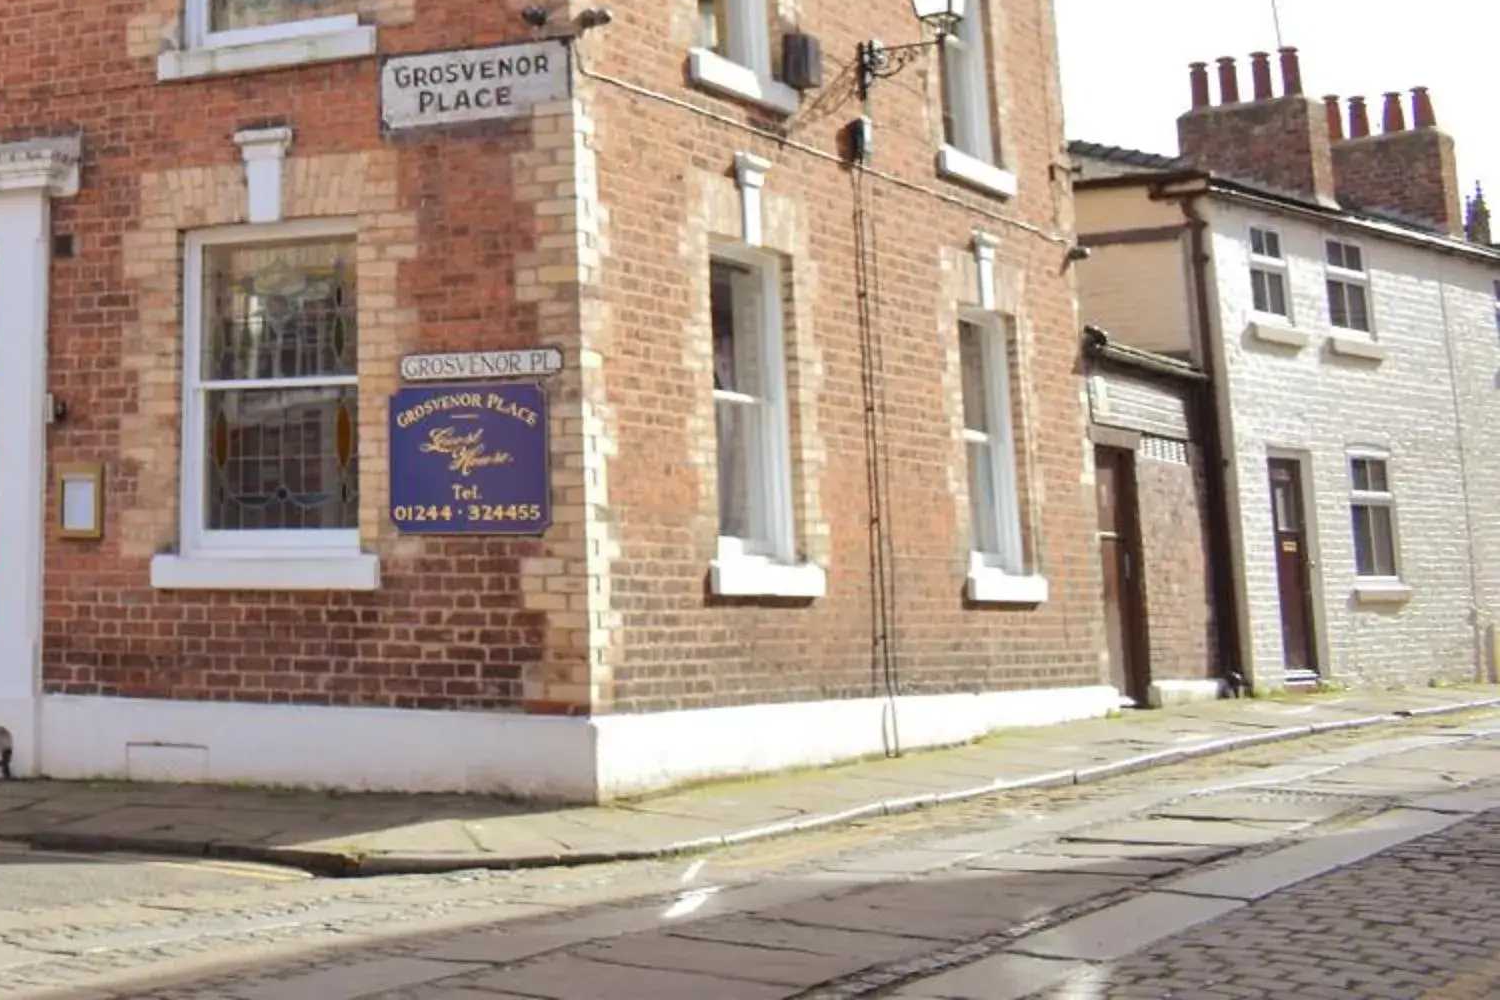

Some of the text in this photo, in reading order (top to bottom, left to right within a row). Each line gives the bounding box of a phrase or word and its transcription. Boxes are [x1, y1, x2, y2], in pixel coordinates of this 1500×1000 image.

[394, 55, 549, 89] GROSVENOR
[419, 86, 513, 114] PLACE
[404, 351, 553, 377] GROSVENOR PL
[396, 392, 539, 428] GROSVENOR PLACE
[452, 483, 483, 501] Tel.
[394, 503, 541, 521] 01244 324455
